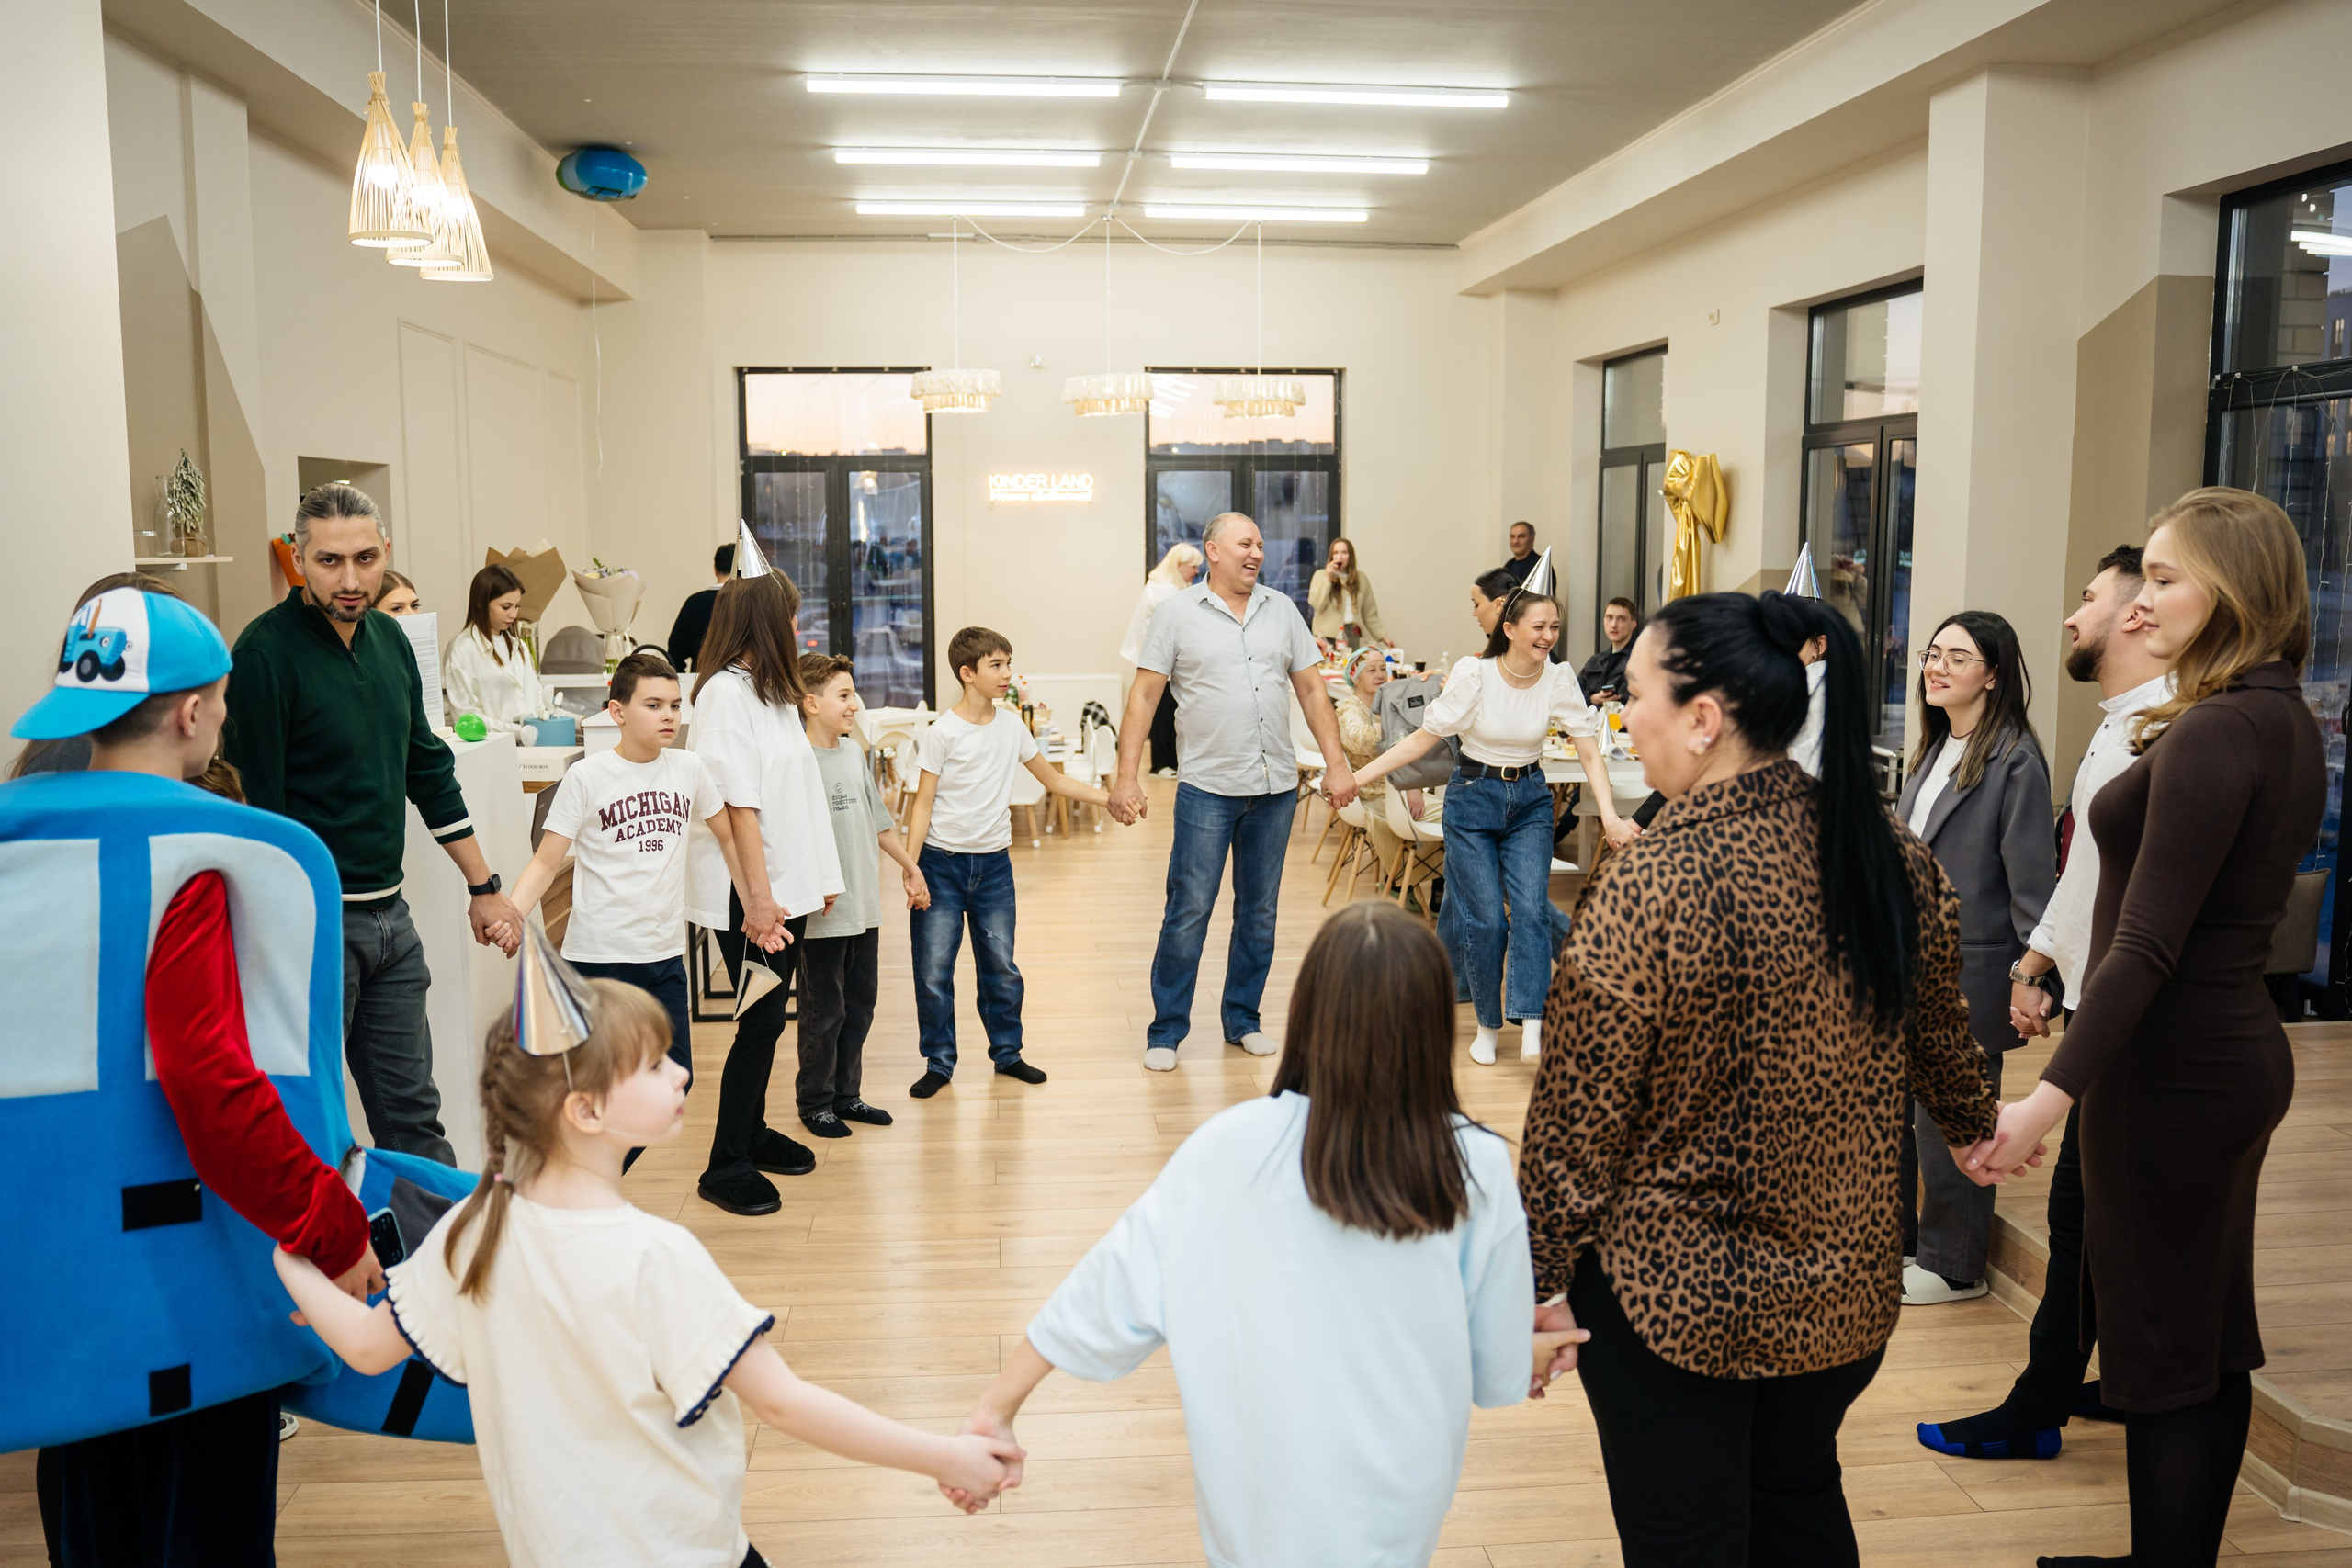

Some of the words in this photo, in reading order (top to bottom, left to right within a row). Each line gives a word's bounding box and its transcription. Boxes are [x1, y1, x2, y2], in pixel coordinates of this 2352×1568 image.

[989, 473, 1047, 488] KINDER
[1051, 473, 1093, 488] LAND
[598, 790, 691, 832] MICHIGAN
[614, 818, 683, 843] ACADEMY
[639, 839, 664, 852] 1996
